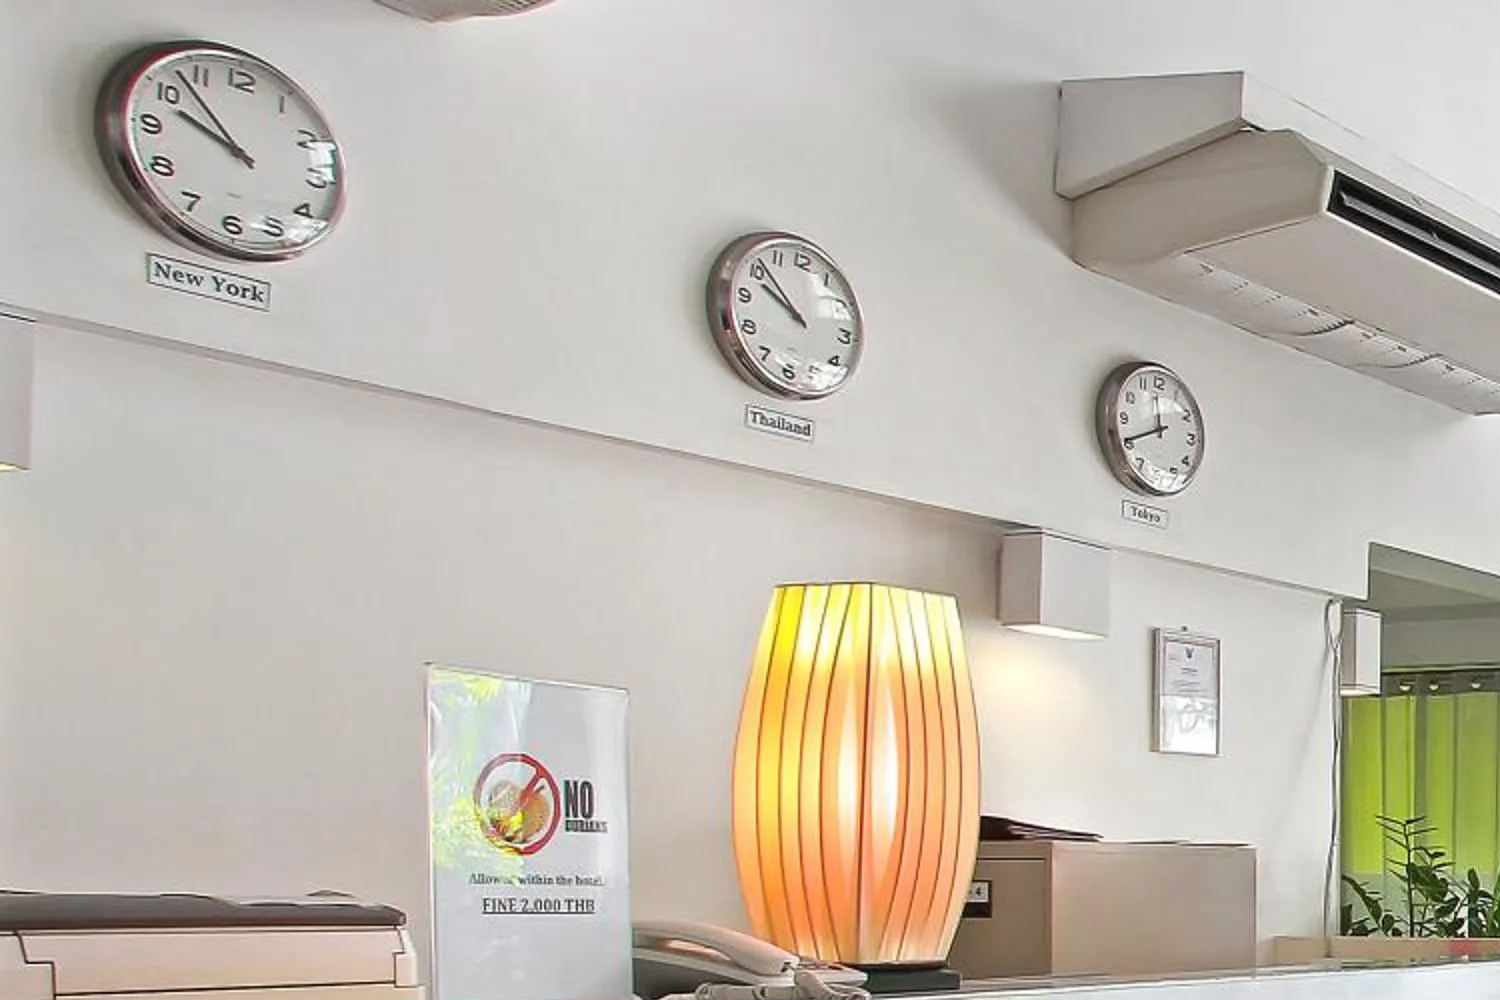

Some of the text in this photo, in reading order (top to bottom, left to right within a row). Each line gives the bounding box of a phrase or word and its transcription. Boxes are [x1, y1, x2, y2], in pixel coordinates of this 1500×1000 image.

[193, 64, 209, 88] 11
[228, 68, 256, 94] 12
[157, 82, 180, 105] 10
[140, 113, 162, 135] 9
[150, 156, 175, 177] 8
[181, 191, 202, 212] 7
[293, 203, 313, 219] 4
[222, 215, 243, 235] 6
[772, 250, 784, 268] 11
[793, 252, 812, 273] 12
[153, 262, 265, 303] New York
[738, 287, 752, 303] 9
[741, 319, 757, 335] 8
[837, 328, 852, 345] 3
[759, 346, 772, 362] 7
[1153, 376, 1165, 391] 12
[750, 411, 811, 437] Thailand
[1130, 506, 1161, 523] Tokyo
[564, 780, 595, 818] NO
[520, 874, 554, 886] within
[556, 874, 573, 886] the
[483, 897, 516, 912] FINE
